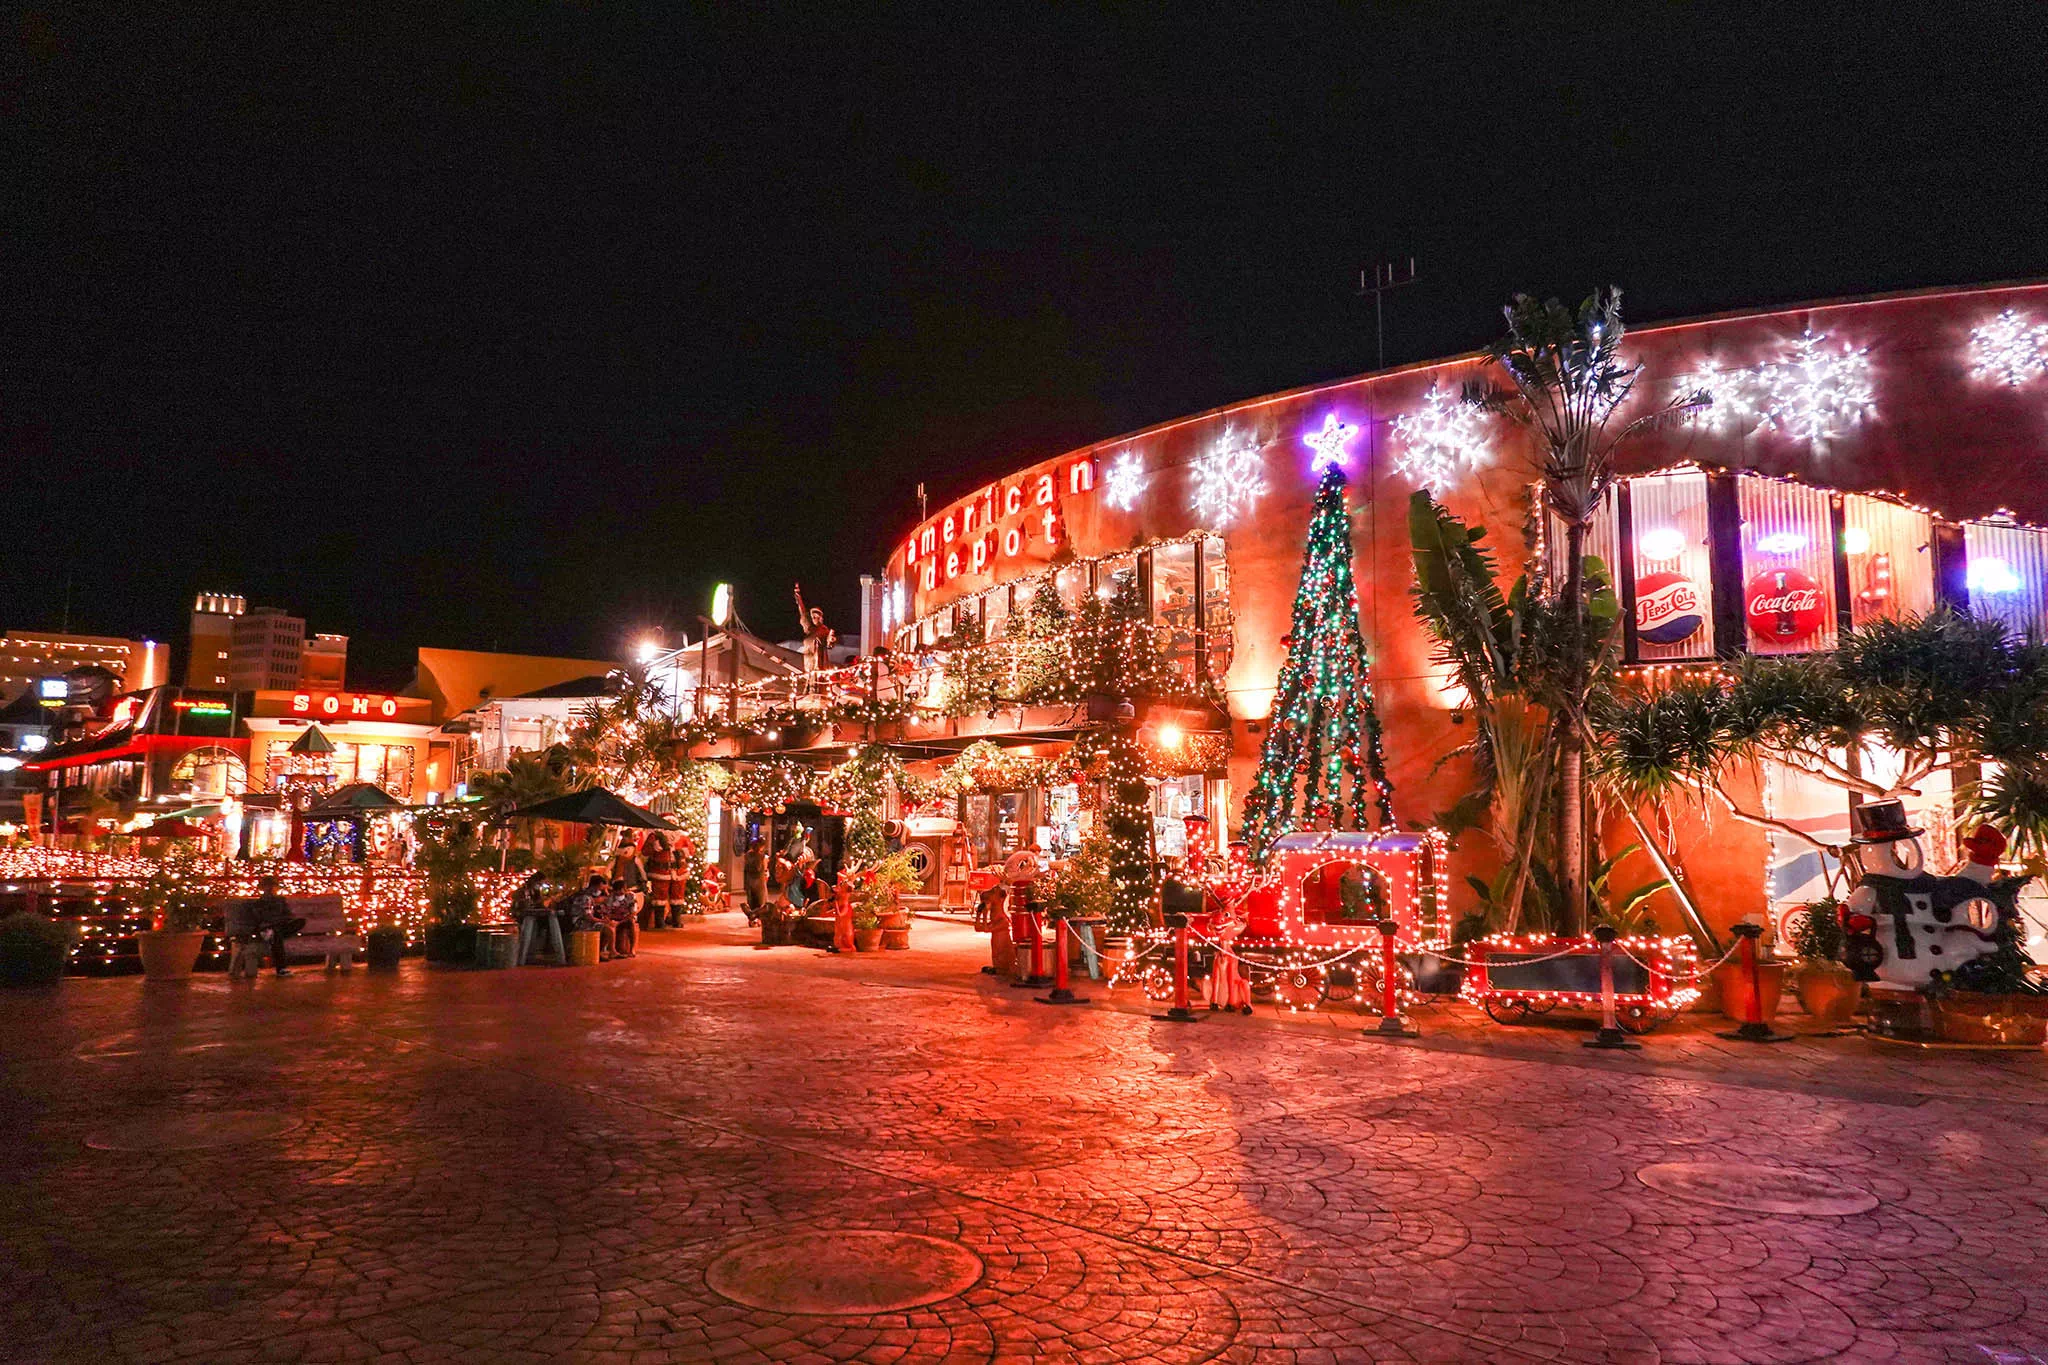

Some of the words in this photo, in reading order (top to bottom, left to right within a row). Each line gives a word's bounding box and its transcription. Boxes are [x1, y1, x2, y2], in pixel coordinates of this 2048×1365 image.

[907, 459, 1094, 566] american
[925, 506, 1057, 591] depot
[1749, 588, 1817, 616] Coca-Cola
[293, 695, 397, 716] SOHO
